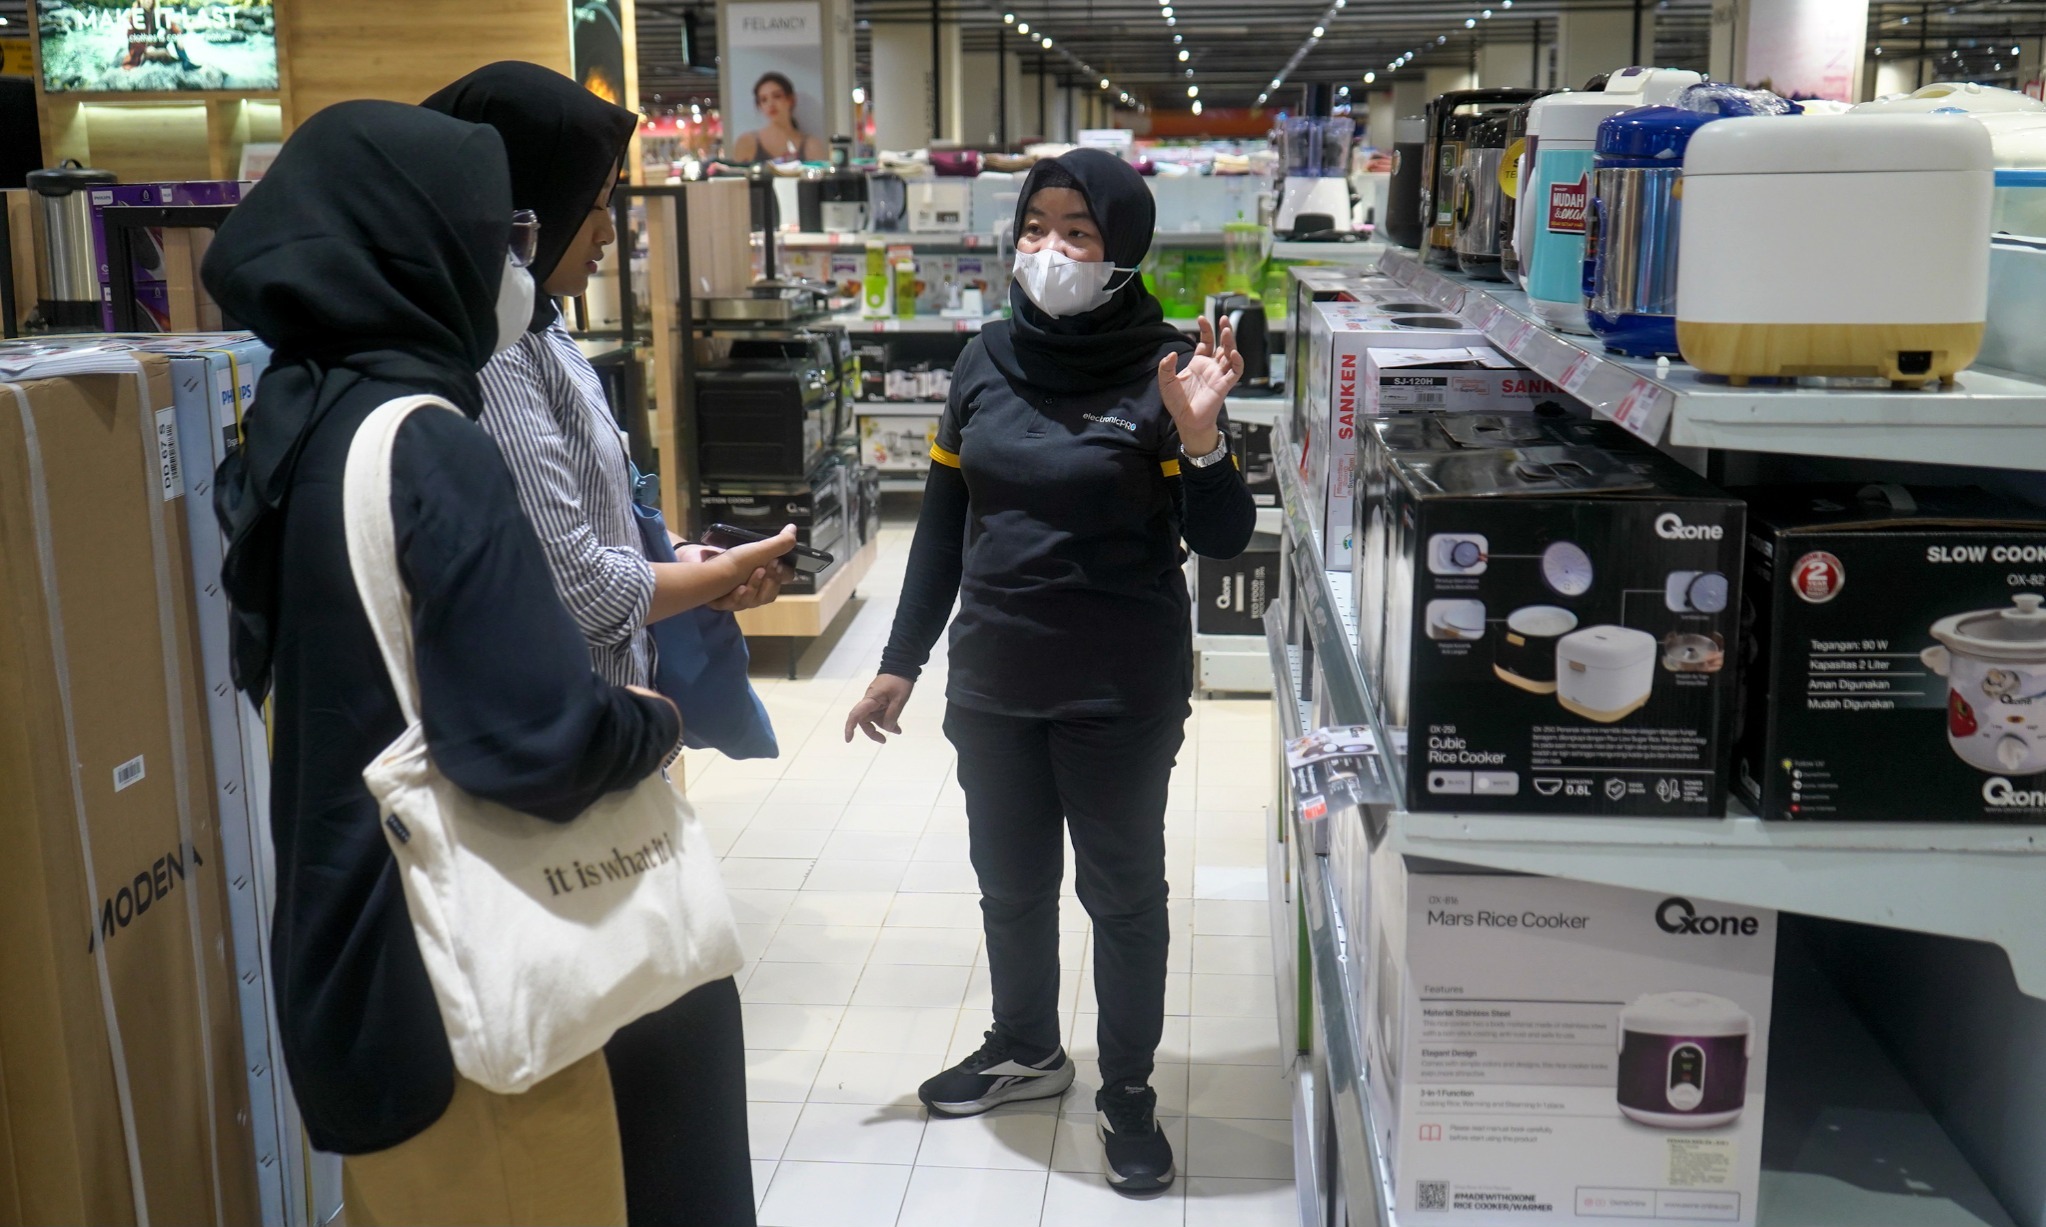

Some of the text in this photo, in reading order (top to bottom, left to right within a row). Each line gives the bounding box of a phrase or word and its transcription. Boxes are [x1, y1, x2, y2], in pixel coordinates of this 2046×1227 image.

[76, 7, 238, 30] MAKE IT LAST
[742, 17, 807, 30] FELANCY
[1553, 192, 1585, 208] MUDAH
[1394, 377, 1433, 386] SJ-120H
[1338, 354, 1357, 440] SANKEN
[1655, 512, 1724, 540] Oxone
[1926, 545, 1988, 563] SLOW
[1806, 561, 1829, 581] 2
[2006, 573, 2046, 587] OX-82
[1810, 640, 1860, 652] Tegangan:
[1876, 640, 1889, 650] W
[1809, 660, 1858, 671] Kapasitas
[1867, 660, 1891, 670] Liter
[1808, 679, 1891, 691] Aman Digunakan
[1807, 699, 1895, 711] Mudah Digunakan
[1429, 736, 1467, 749] Cubic
[1429, 750, 1506, 764] Rice Cooker
[1981, 776, 2046, 807] Oxon
[543, 867, 573, 896] it
[573, 861, 602, 889] is
[599, 847, 657, 882] what
[1427, 910, 1591, 929] Mars Rice Cooker
[1655, 896, 1759, 936] Oxone
[1424, 985, 1464, 994] Features
[1451, 1049, 1478, 1058] Design
